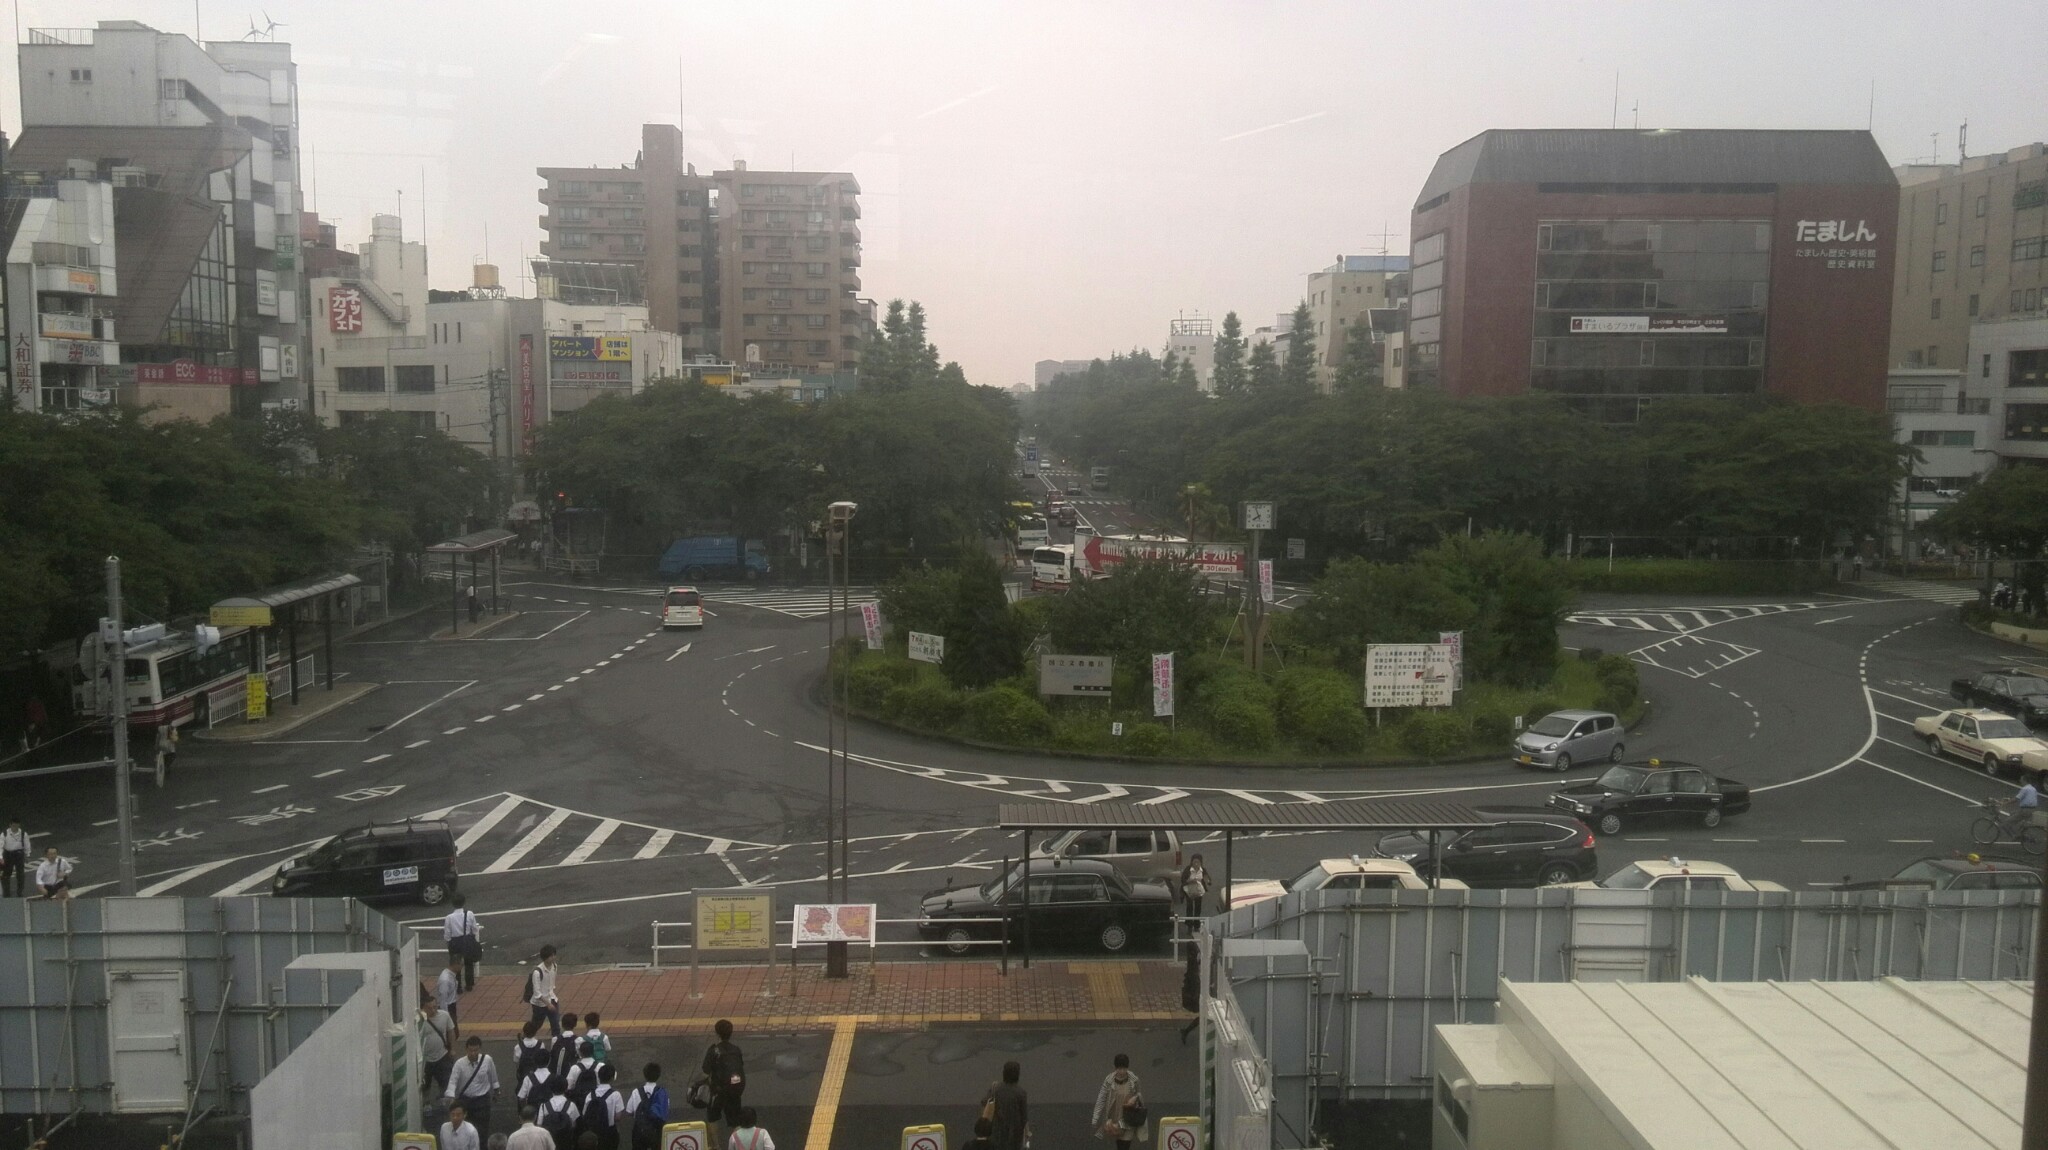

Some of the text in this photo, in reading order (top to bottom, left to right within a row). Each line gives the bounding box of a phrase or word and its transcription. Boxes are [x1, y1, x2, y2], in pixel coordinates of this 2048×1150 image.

[1796, 219, 1877, 243] たましん
[332, 295, 348, 331] カフェ
[346, 289, 361, 331] ネット
[551, 339, 582, 348] アパート
[85, 346, 100, 358] BBC
[551, 349, 590, 357] マンション
[15, 332, 33, 394] 大和証券
[175, 363, 196, 378] ECC
[1212, 550, 1238, 563] 2015
